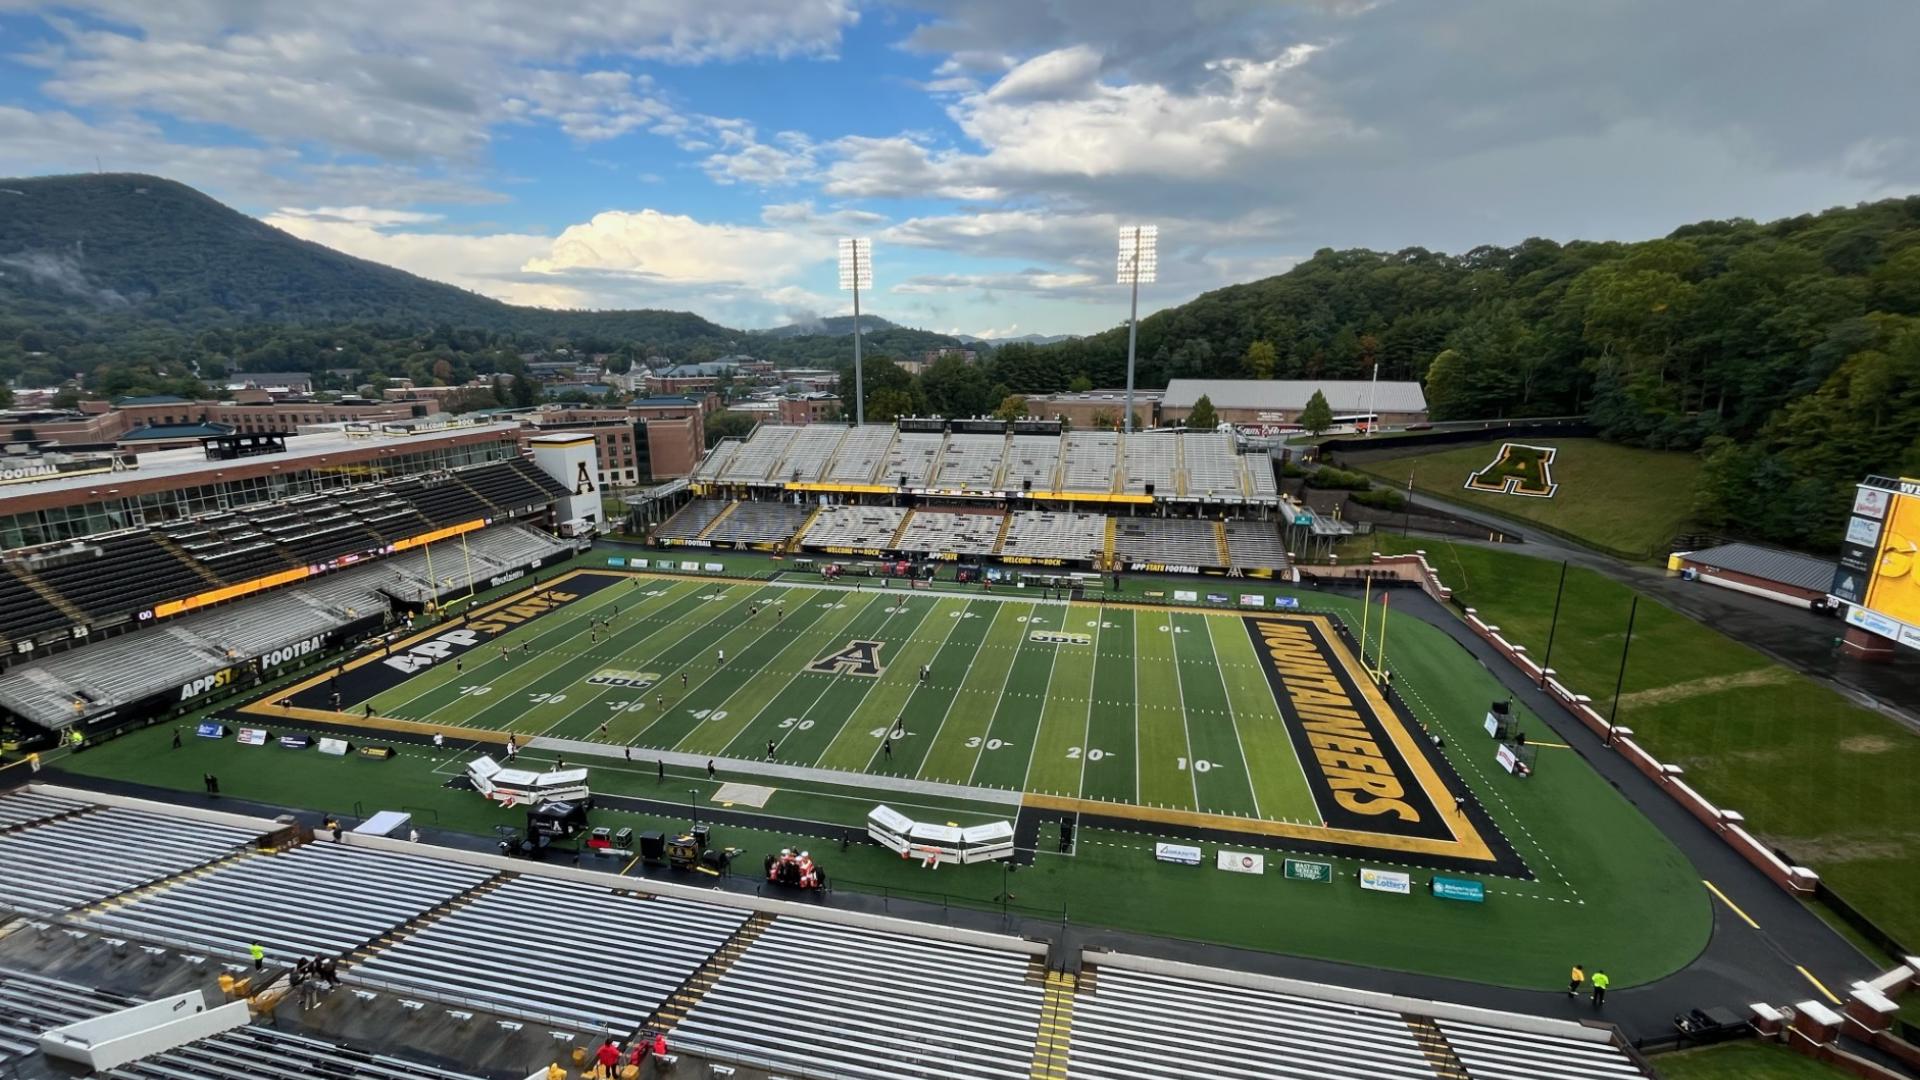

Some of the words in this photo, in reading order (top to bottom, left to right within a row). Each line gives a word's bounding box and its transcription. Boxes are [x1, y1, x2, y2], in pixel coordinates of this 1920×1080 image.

[575, 461, 595, 495] A
[1165, 564, 1200, 574] FOOTBALL
[804, 639, 887, 677] A
[778, 717, 815, 730] 50
[1255, 621, 1420, 823] MOUNTAINEERS
[965, 736, 1003, 750] 30
[1065, 747, 1104, 760] 20
[1177, 757, 1212, 772] 10
[1375, 880, 1408, 891] Lottery
